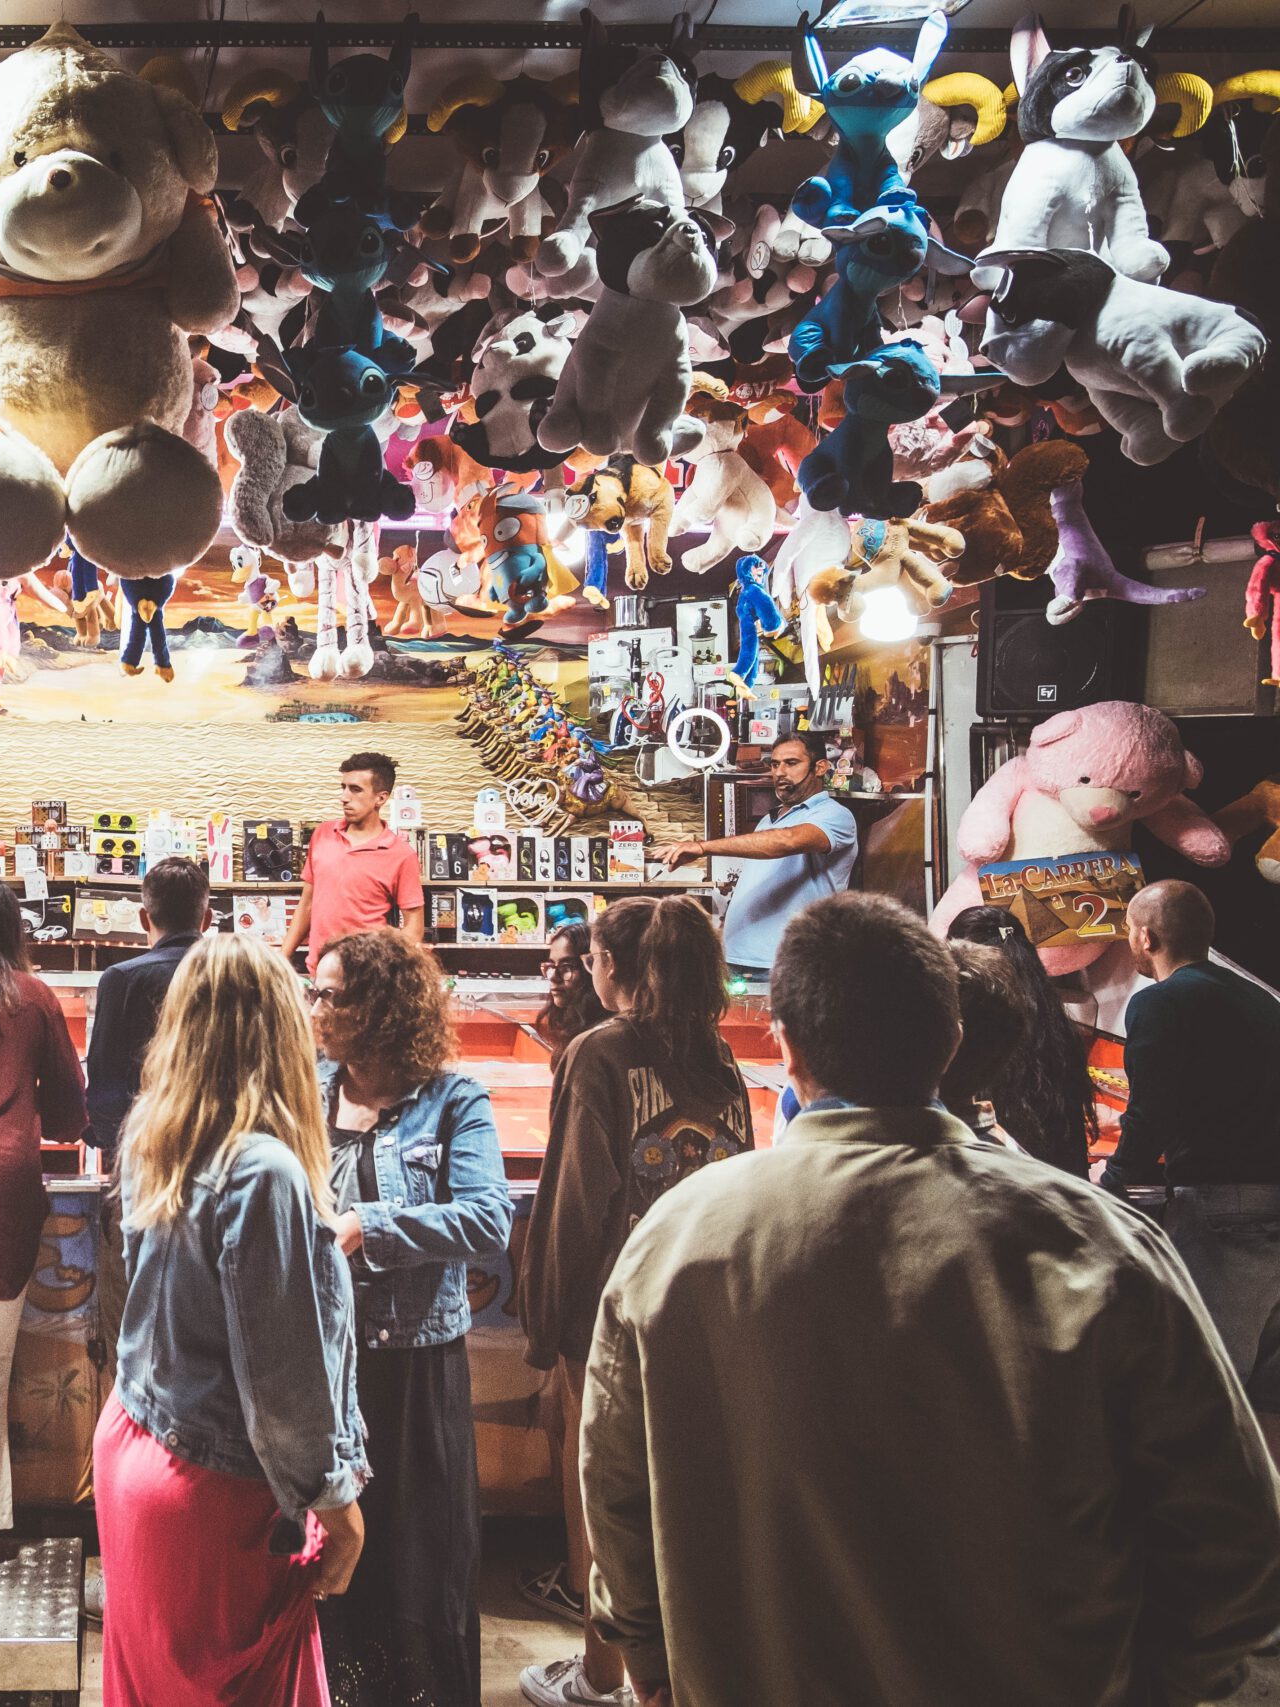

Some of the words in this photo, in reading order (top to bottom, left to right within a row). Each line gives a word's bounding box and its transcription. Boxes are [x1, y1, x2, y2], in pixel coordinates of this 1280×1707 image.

[435, 861, 445, 874] 6
[453, 860, 462, 875] 6
[983, 872, 1020, 898] La
[1020, 855, 1138, 892] CARRERA
[1051, 893, 1066, 910] a
[1073, 893, 1117, 937] 2
